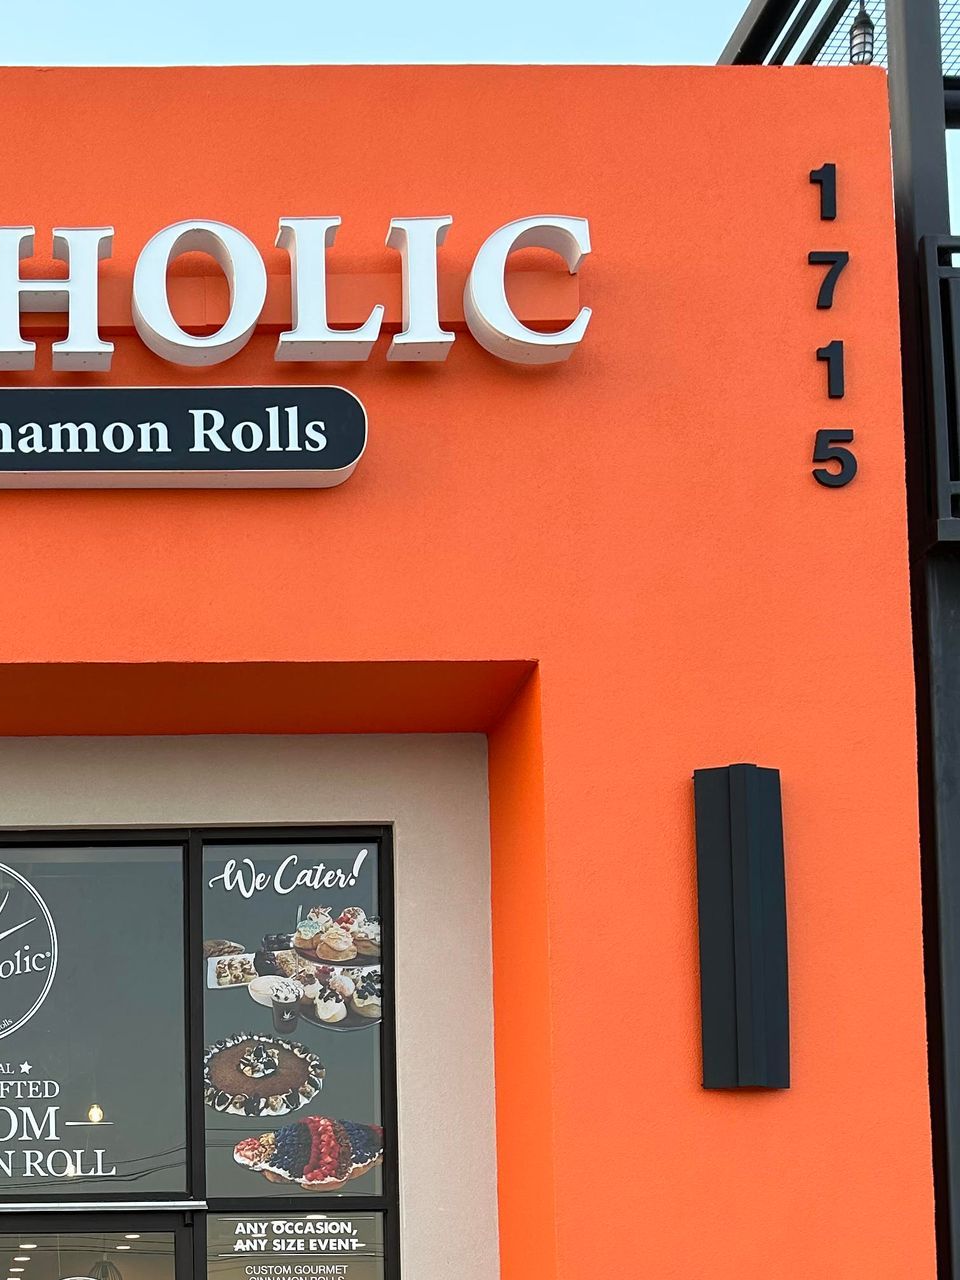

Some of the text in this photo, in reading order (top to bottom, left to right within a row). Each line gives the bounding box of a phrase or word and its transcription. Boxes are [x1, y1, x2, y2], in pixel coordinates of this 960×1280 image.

[188, 405, 328, 453] Rolls
[209, 848, 369, 898] We Cater!
[22, 1149, 116, 1178] ROLL
[234, 1221, 358, 1236] ANY OCCASION,
[234, 1238, 358, 1251] ANY SIZE EVENT
[245, 1265, 348, 1275] CUSTOM GOURMET
